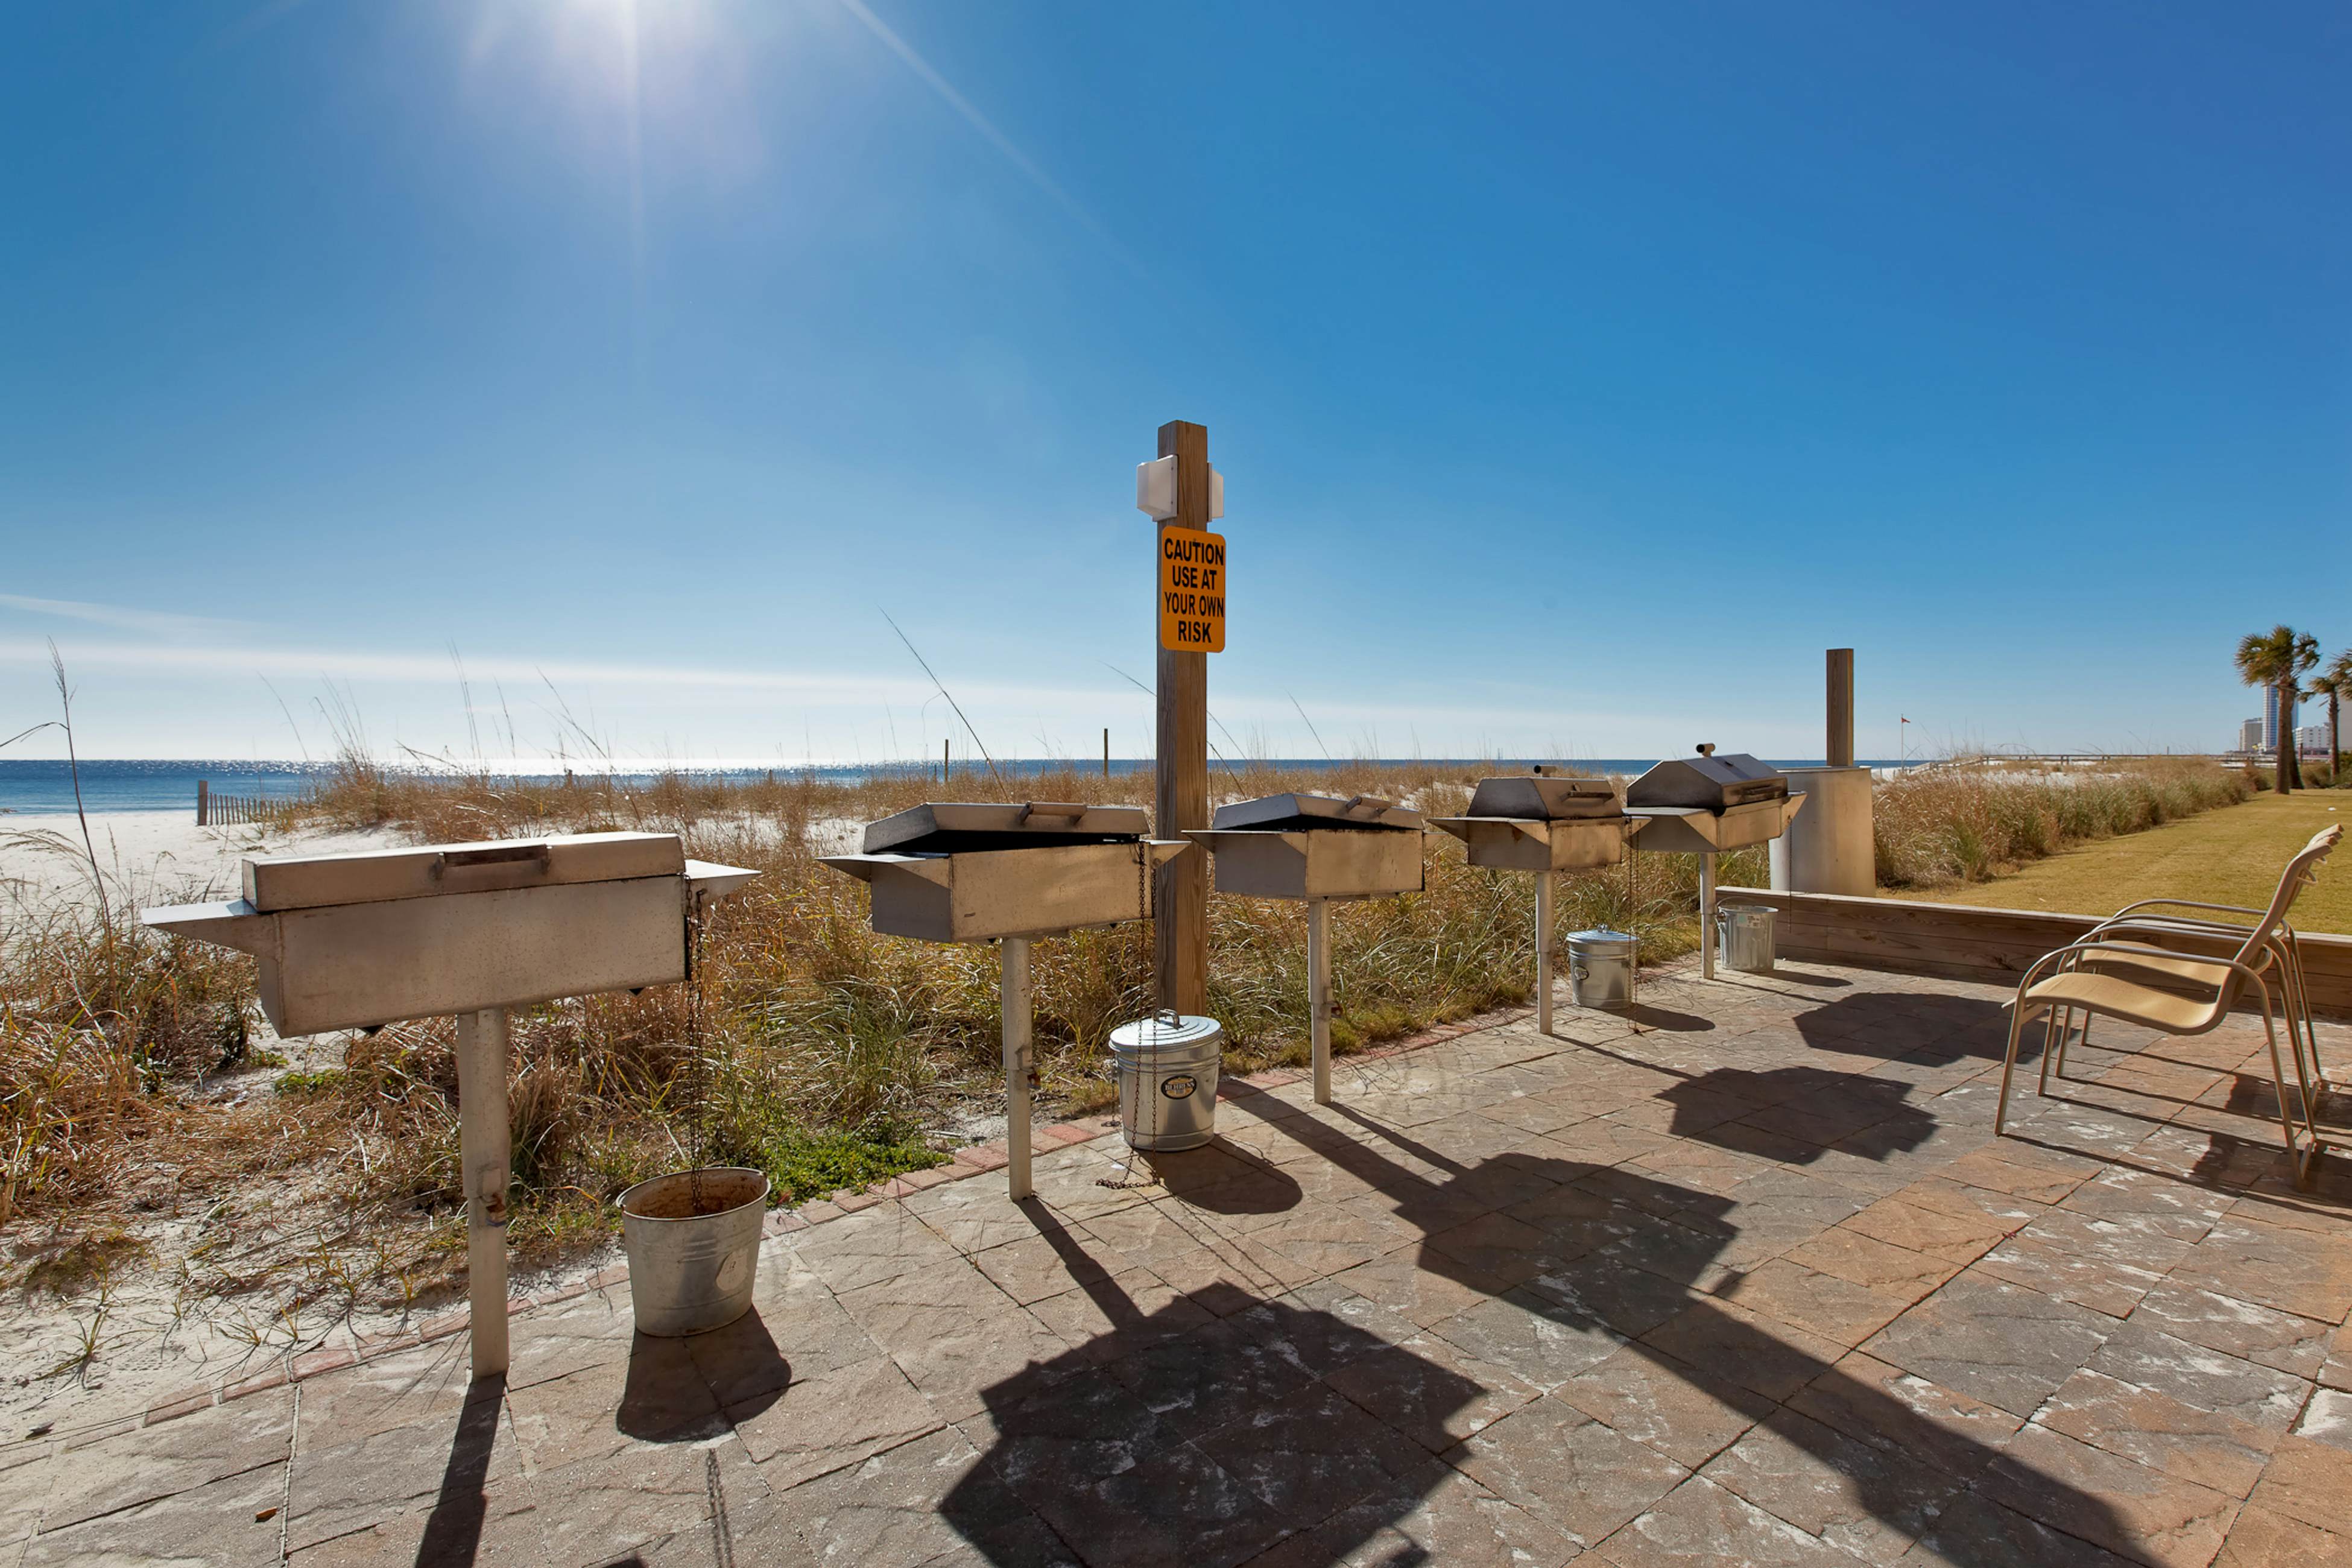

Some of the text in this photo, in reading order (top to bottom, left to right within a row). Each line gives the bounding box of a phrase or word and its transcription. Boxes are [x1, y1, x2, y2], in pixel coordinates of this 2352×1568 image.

[1165, 538, 1224, 566] CAUTION
[1172, 566, 1217, 590] USE AT
[1165, 592, 1224, 618] YOUR OWN
[1178, 621, 1212, 643] RISK
